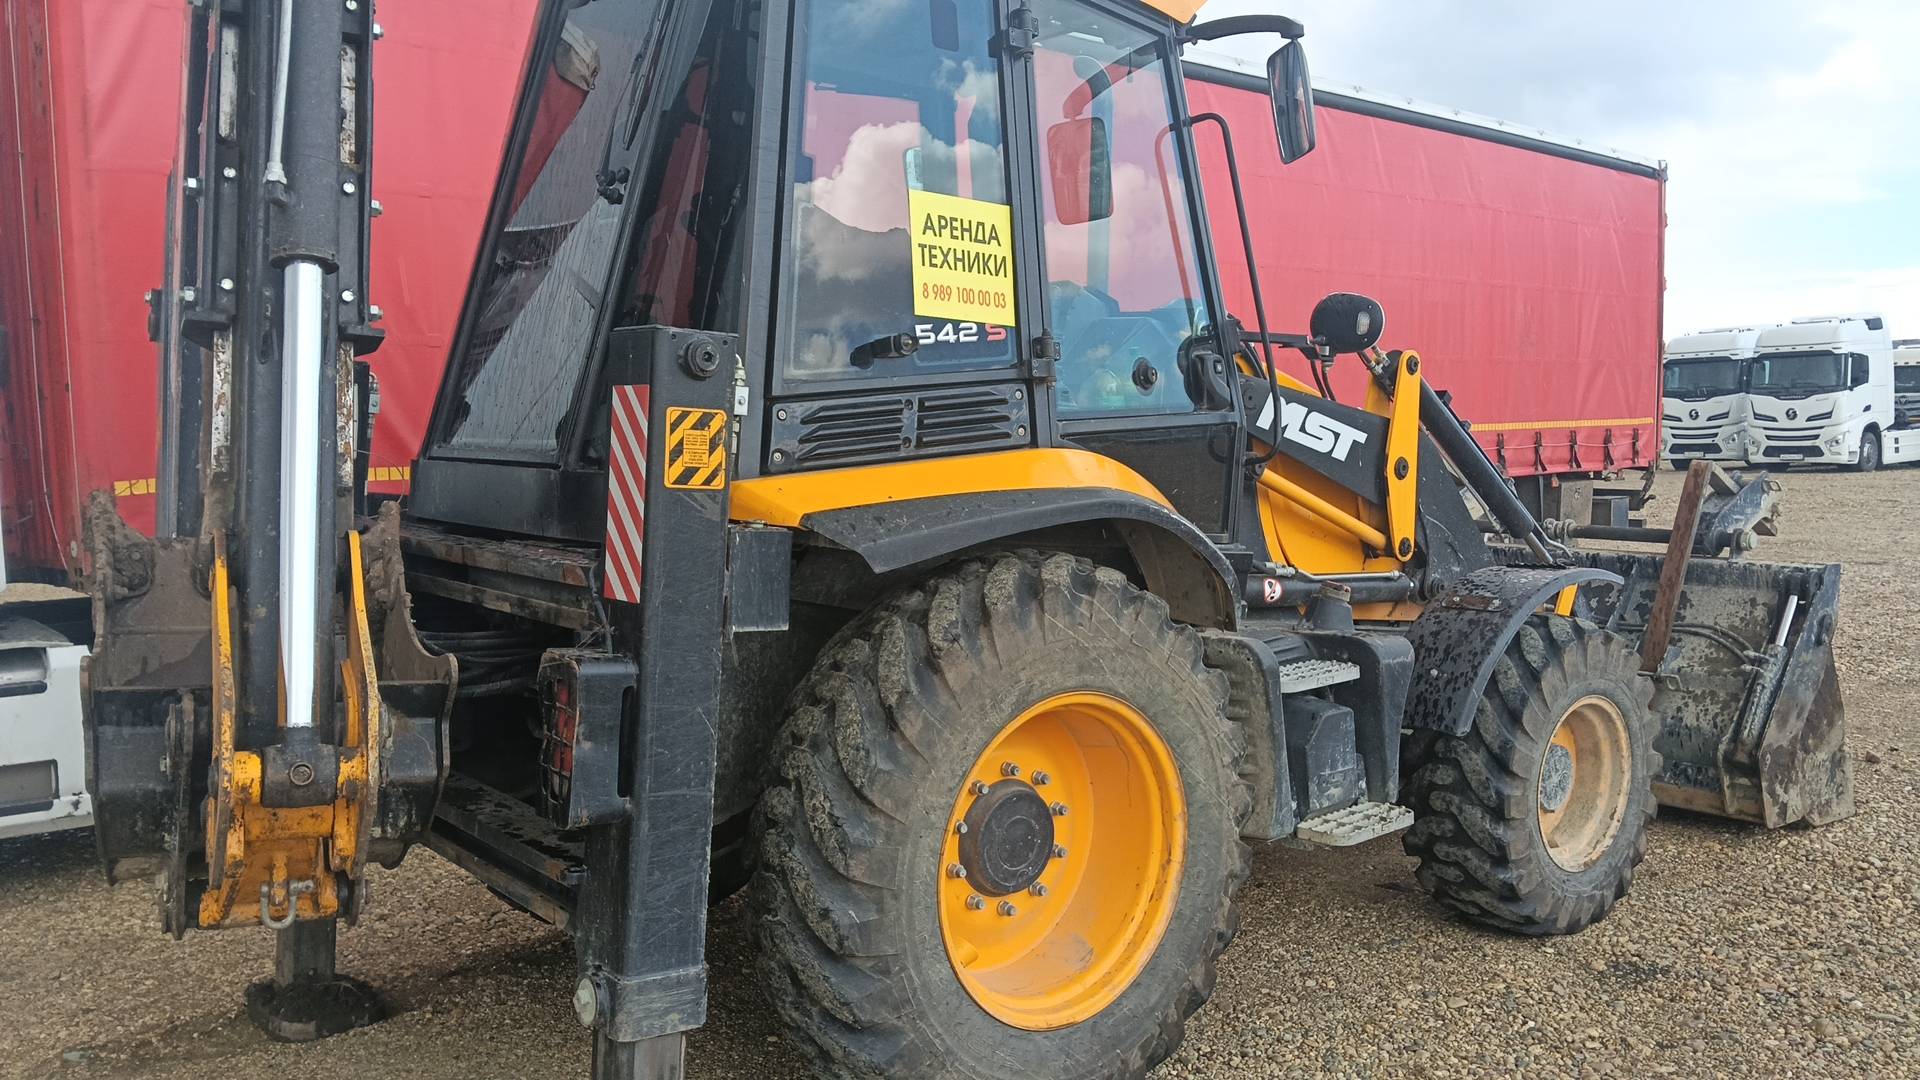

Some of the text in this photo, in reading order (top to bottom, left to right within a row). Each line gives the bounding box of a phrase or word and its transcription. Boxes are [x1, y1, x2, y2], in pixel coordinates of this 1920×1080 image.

[922, 213, 1002, 246] АРЕНДА
[918, 243, 1008, 278] ТЕХНИКИ
[922, 282, 1007, 309] 8 989 100 00 03
[914, 322, 1007, 345] 542 S
[1256, 391, 1368, 462] MST
